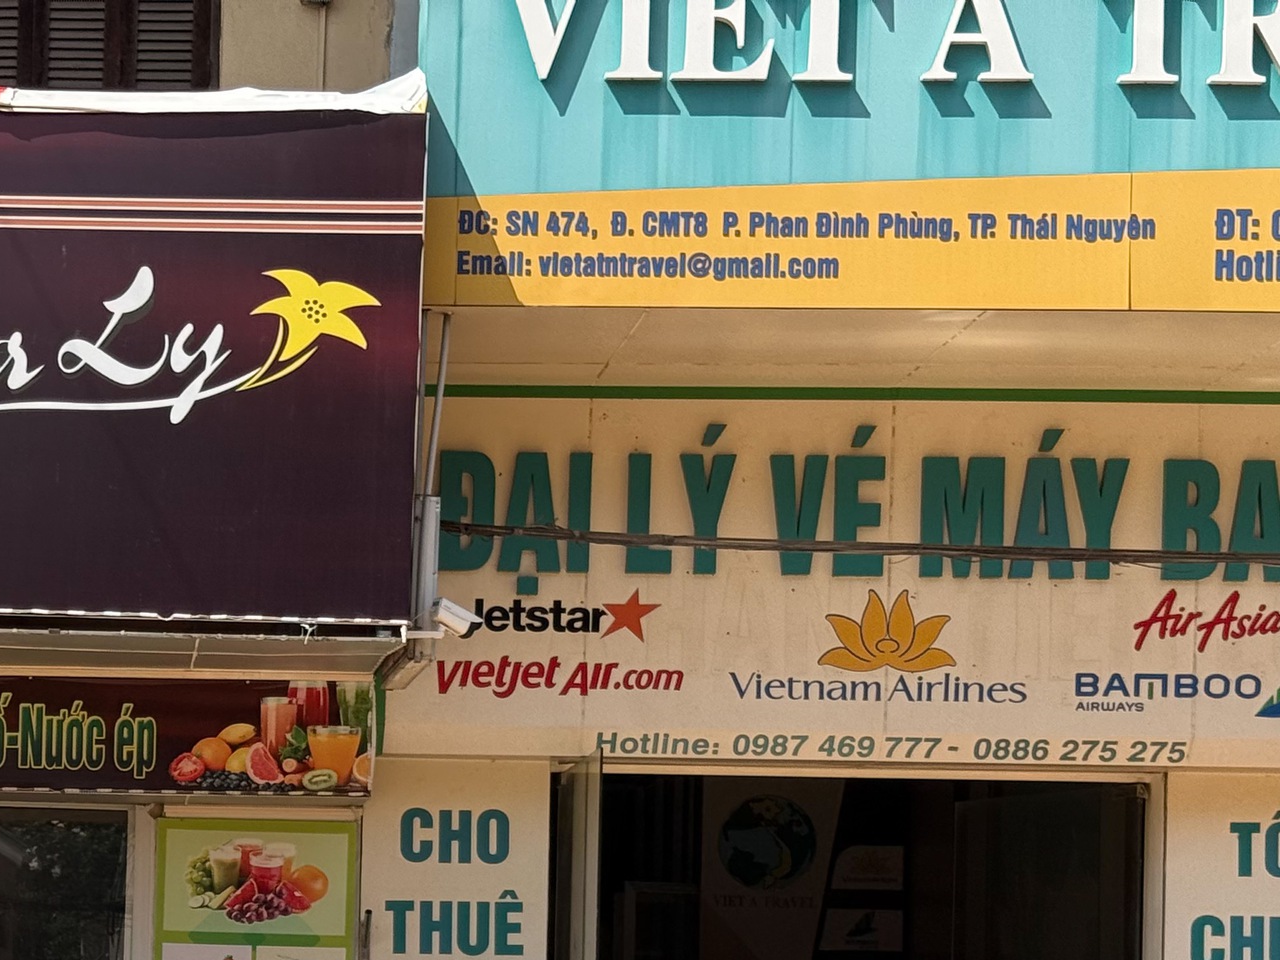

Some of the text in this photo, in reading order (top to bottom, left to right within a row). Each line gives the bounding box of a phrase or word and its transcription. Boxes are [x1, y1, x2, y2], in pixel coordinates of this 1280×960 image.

[920, 0, 1035, 83] A
[457, 210, 1157, 243] ĐC: SN 474, Đ. CMT8 P. Phan Đình Phùng, TP. Thái Nguyên
[1214, 208, 1261, 241] ĐT:
[456, 250, 532, 277] Email:
[57, 265, 247, 425] Ly
[438, 423, 1280, 595] ĐẠI LÝ VÉ MÁY BA
[470, 598, 607, 634] Jetstar
[727, 671, 1028, 704] Vietnam Airlines
[1074, 672, 1262, 700] BAMBOO
[1074, 701, 1145, 712] AIRWAYS
[113, 702, 158, 780] ép
[596, 731, 720, 756] Hotline:
[732, 733, 810, 757] 0987
[818, 735, 876, 758] 469
[972, 738, 1050, 761] 0886
[1058, 739, 1119, 763] 275
[1125, 740, 1187, 764] 275
[399, 806, 511, 865] CHO
[384, 889, 525, 956] THUÊ
